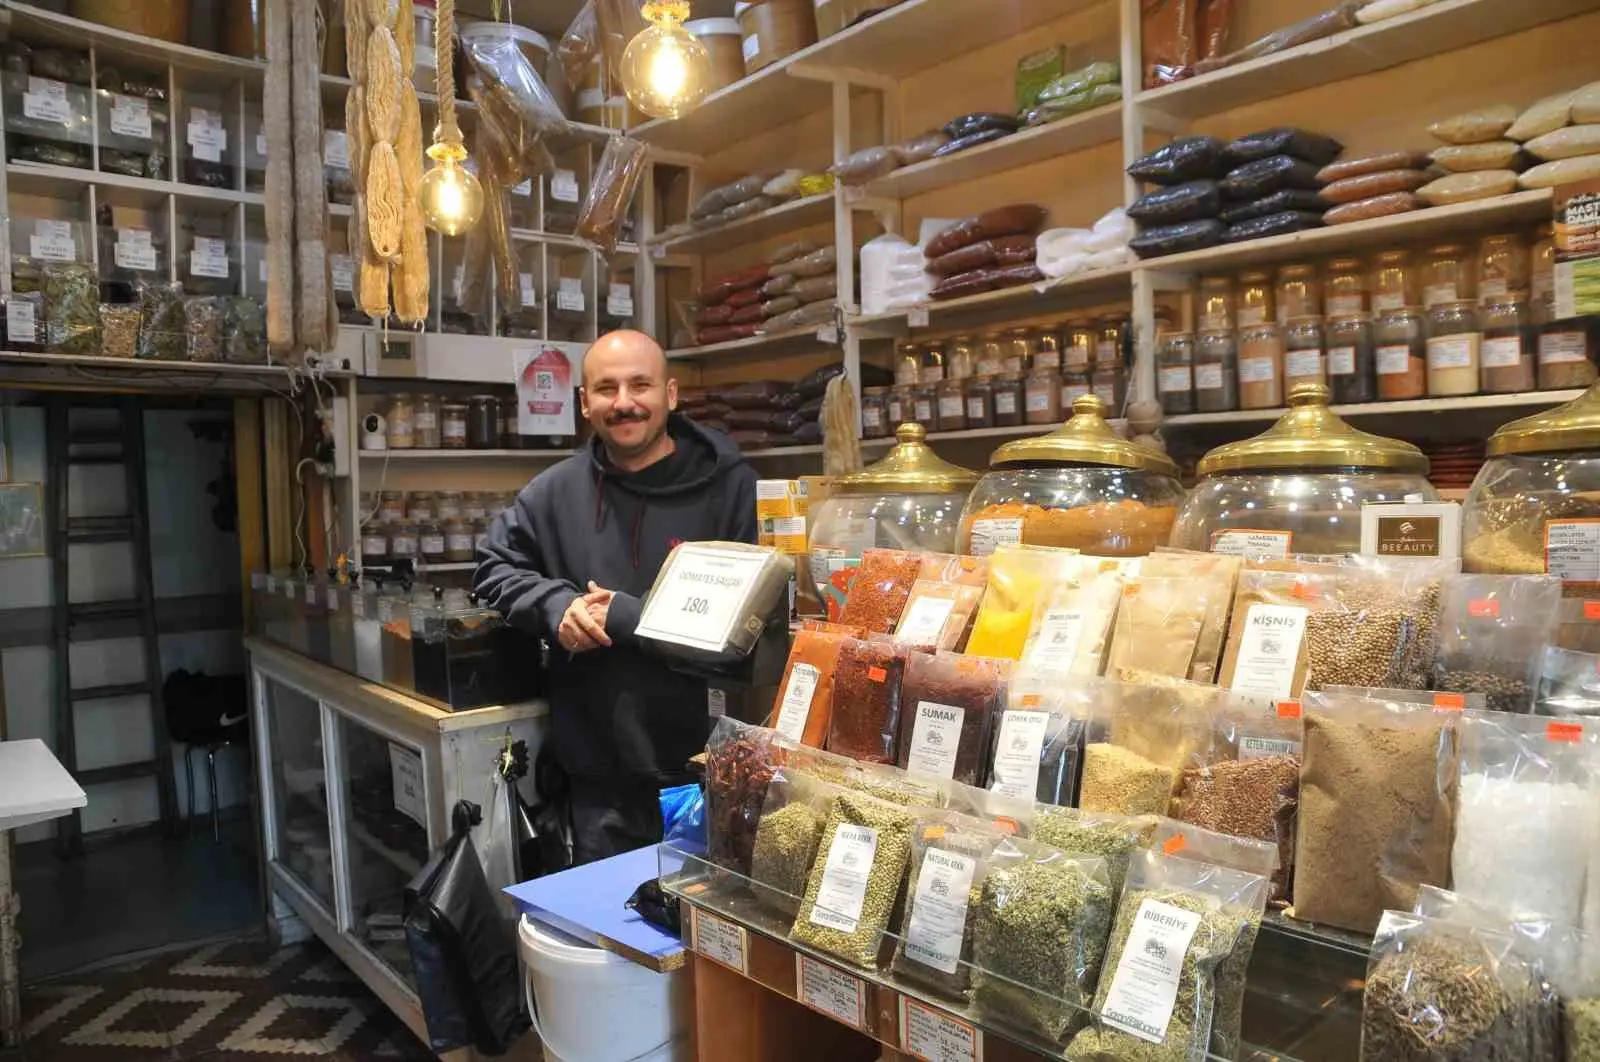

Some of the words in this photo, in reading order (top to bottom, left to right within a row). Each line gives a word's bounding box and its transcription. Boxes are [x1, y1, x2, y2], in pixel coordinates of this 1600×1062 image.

[1382, 543, 1434, 552] BEEAUTY
[1253, 614, 1296, 627] KİŞNİŞ
[921, 707, 957, 722] SUMAK
